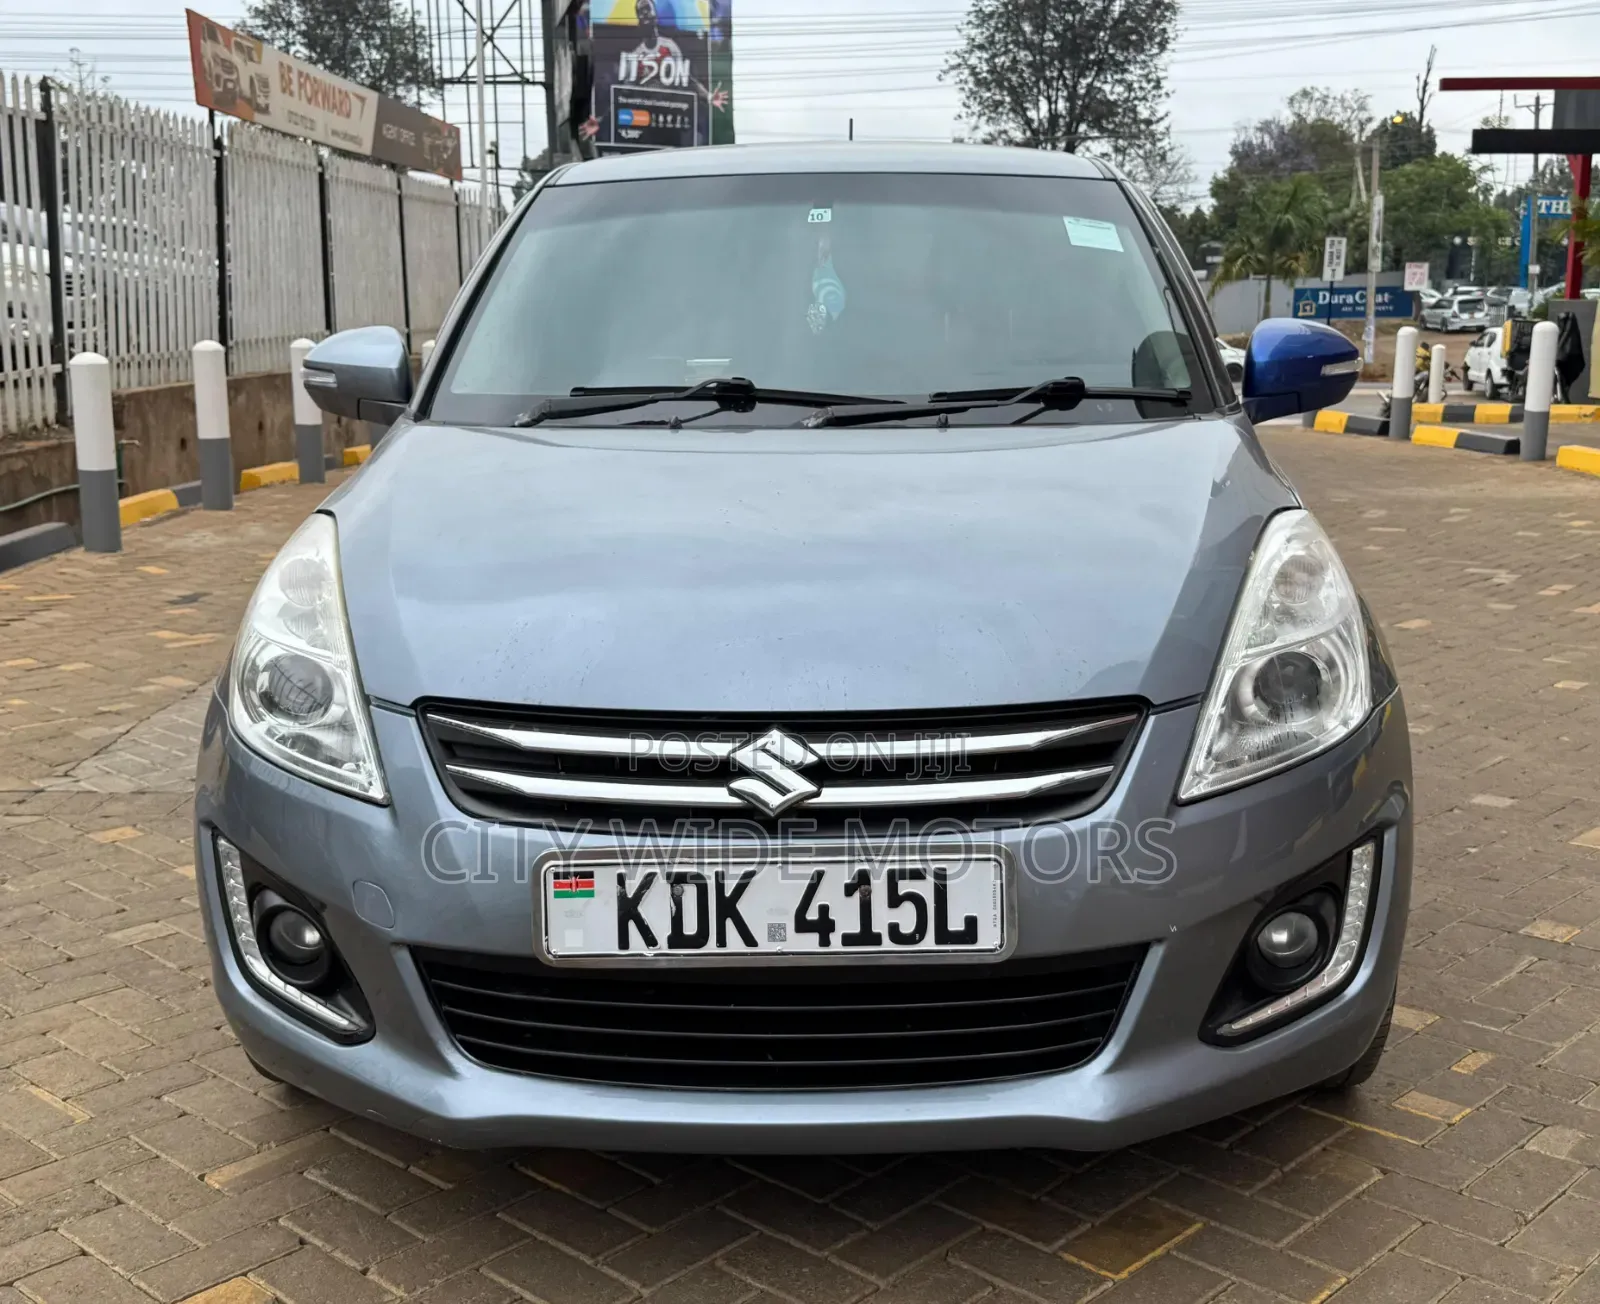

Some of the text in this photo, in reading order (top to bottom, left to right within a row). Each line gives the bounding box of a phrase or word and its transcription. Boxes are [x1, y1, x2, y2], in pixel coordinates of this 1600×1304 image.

[279, 61, 352, 119] BE FORWARD
[660, 57, 690, 87] ON
[1318, 290, 1390, 304] DuraCat
[616, 866, 978, 951] KDK 415L
